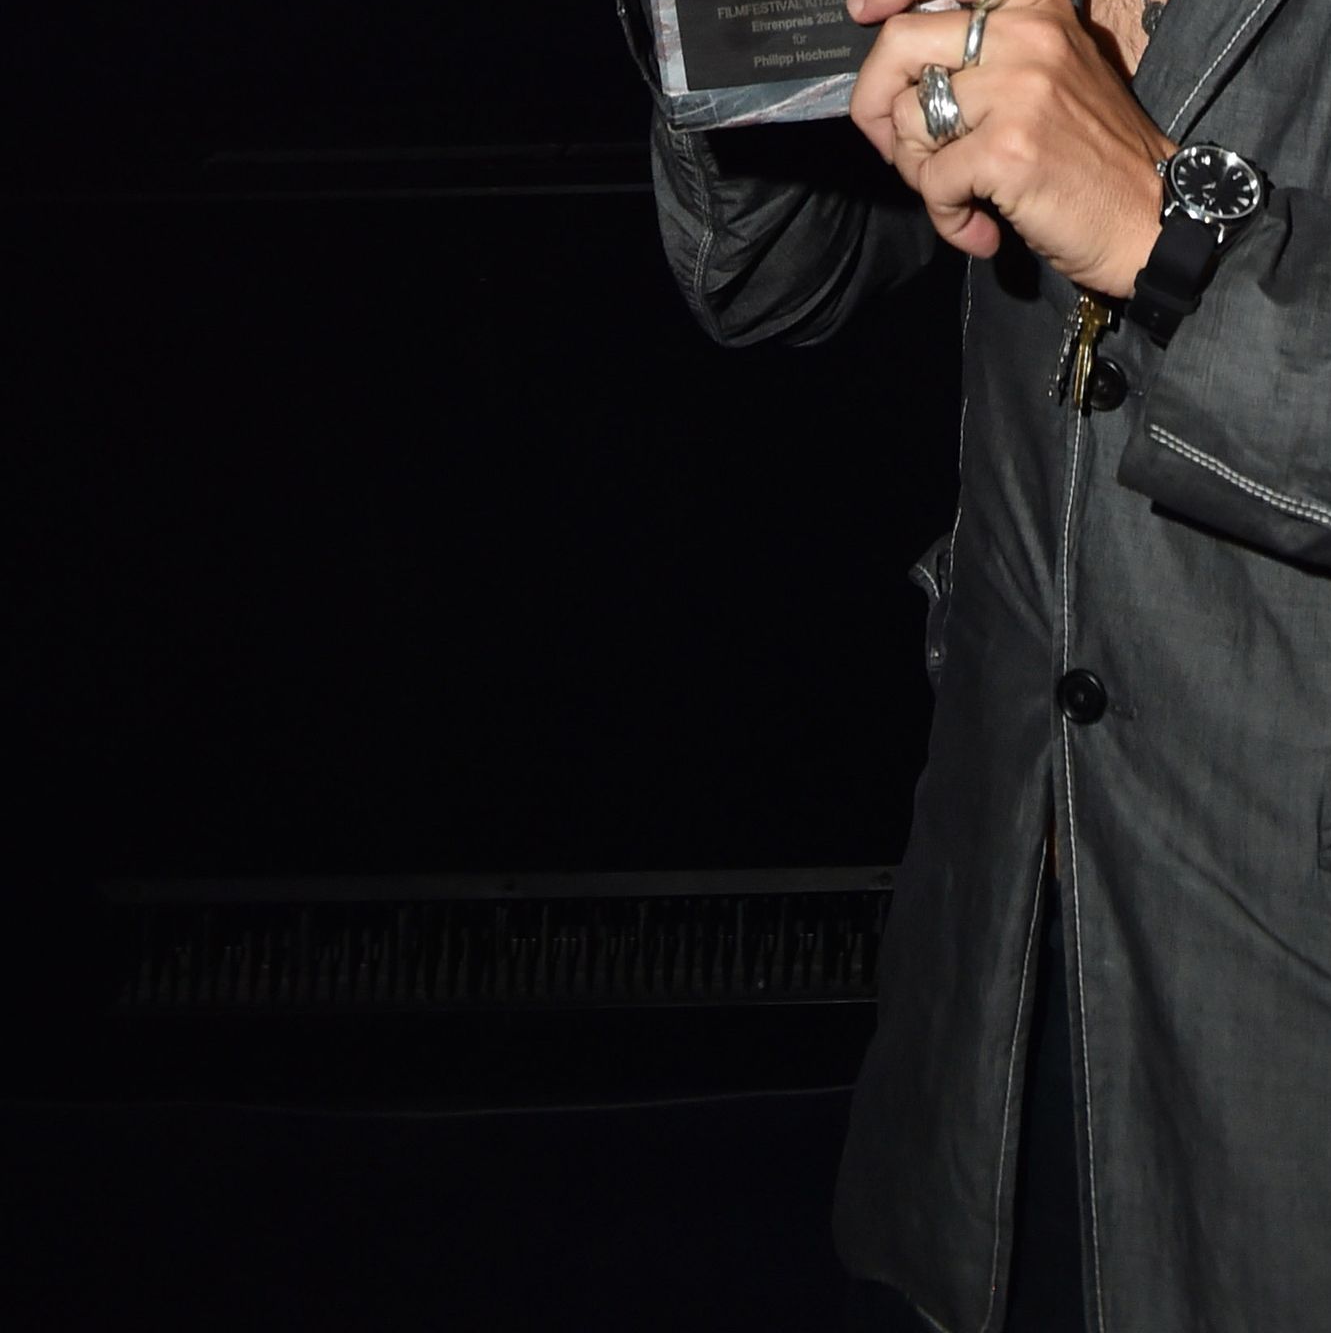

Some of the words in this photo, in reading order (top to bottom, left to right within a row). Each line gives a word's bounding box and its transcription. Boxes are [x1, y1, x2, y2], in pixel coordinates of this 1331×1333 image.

[751, 15, 814, 33] Ehrenpreis
[816, 10, 843, 25] 2024
[792, 34, 807, 46] für
[753, 52, 793, 68] Philipp
[796, 46, 852, 63] Hochmair
